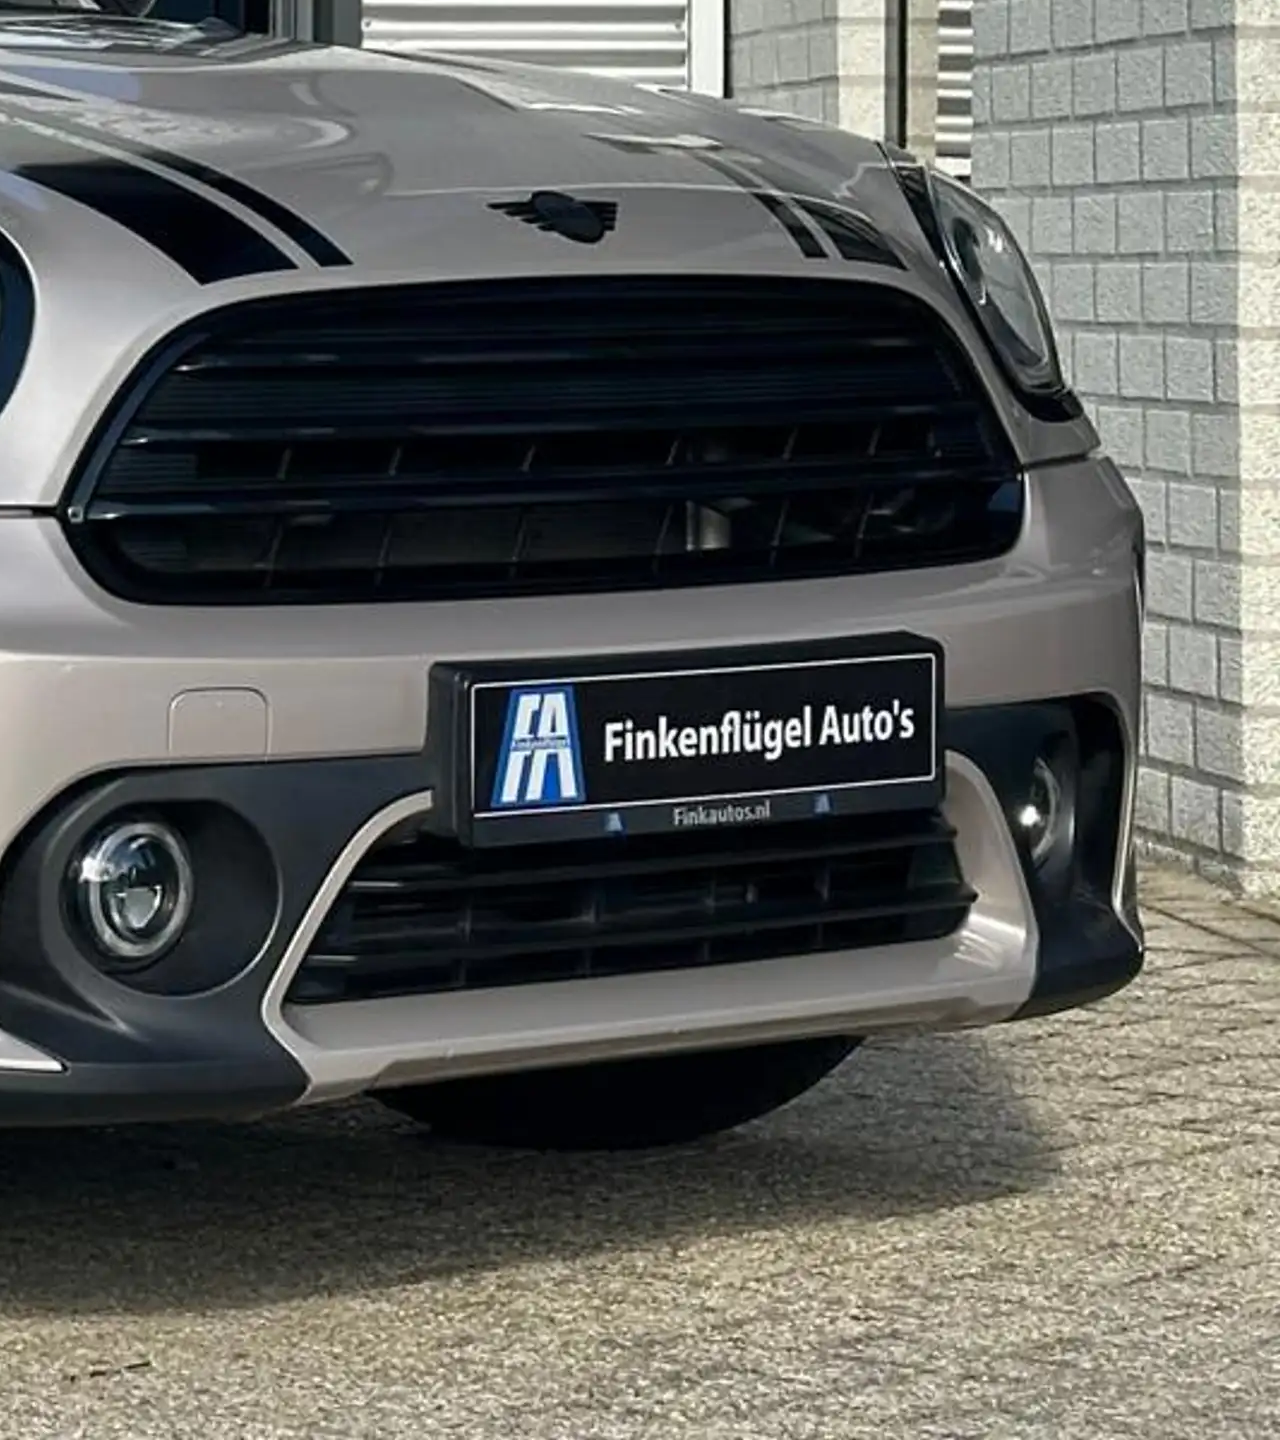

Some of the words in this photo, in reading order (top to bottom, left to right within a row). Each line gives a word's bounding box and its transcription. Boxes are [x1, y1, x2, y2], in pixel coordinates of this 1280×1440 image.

[604, 705, 812, 762] Finkenflügel
[819, 699, 915, 745] Auto's
[673, 800, 771, 827] Finkautos.nl
